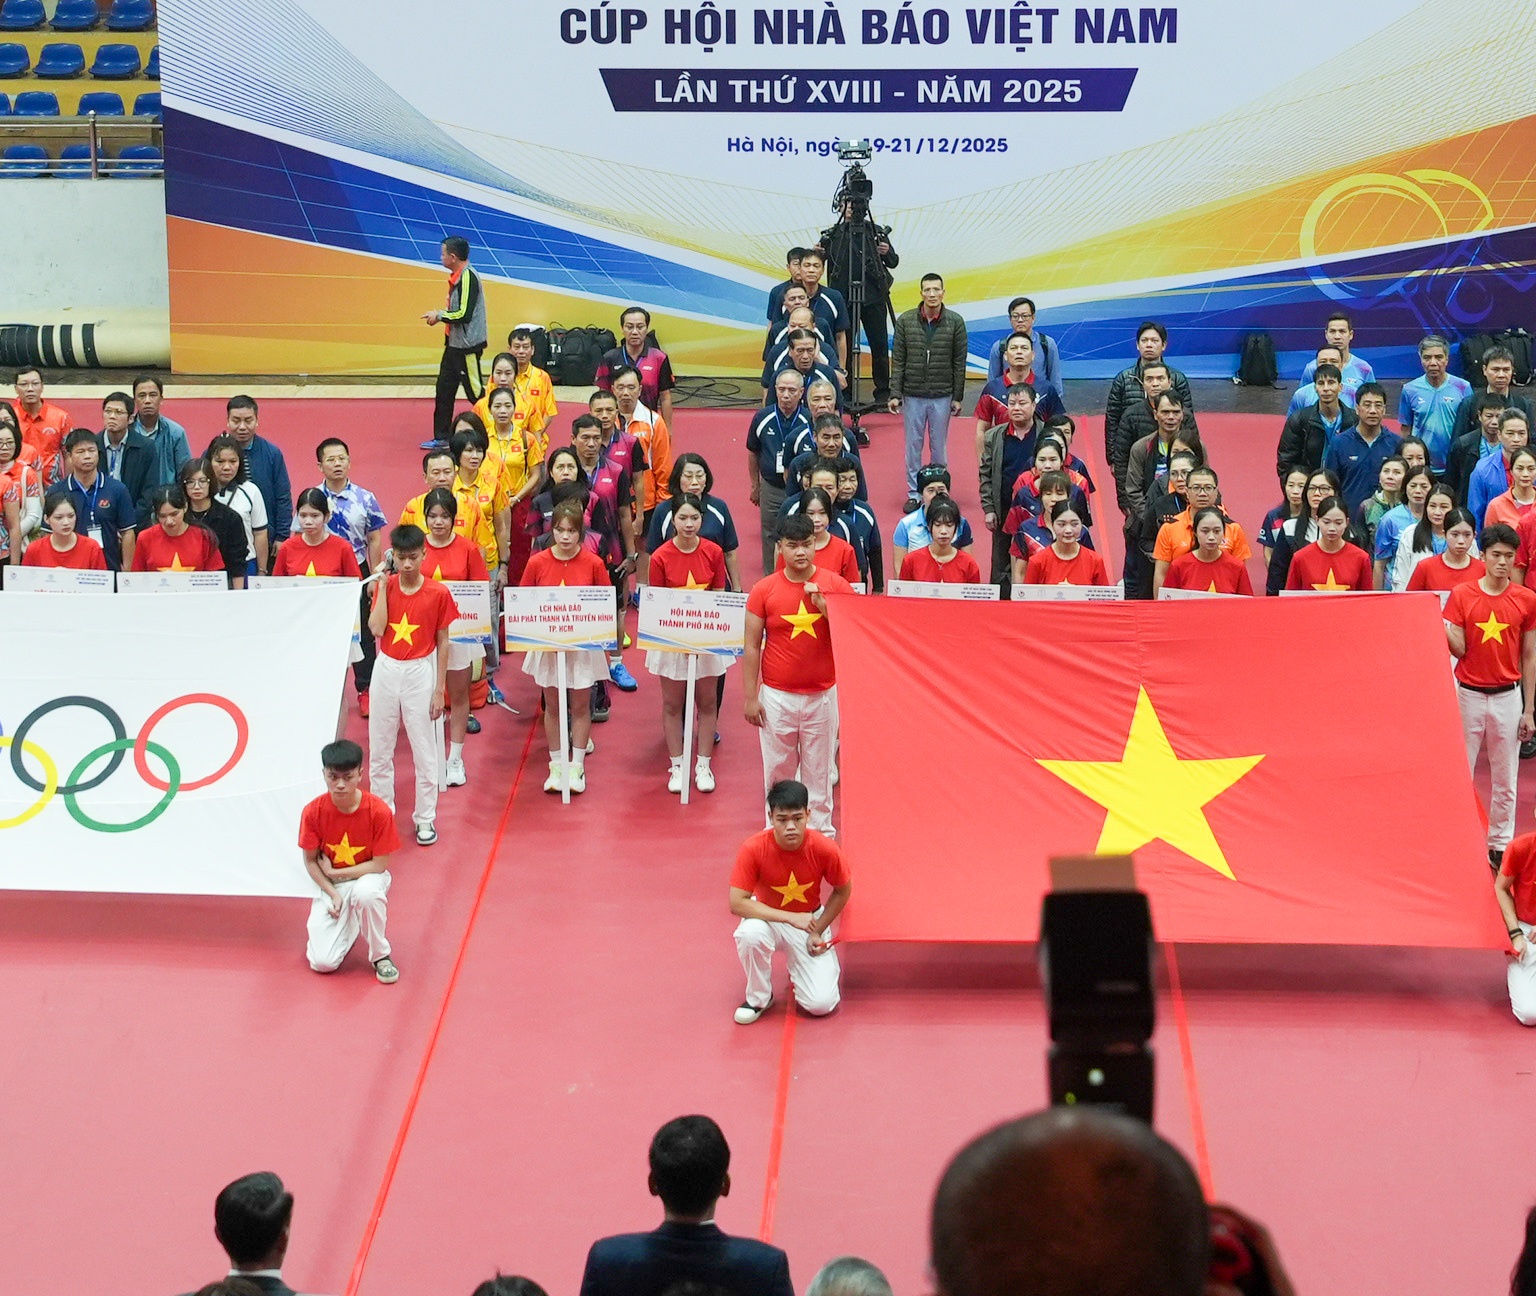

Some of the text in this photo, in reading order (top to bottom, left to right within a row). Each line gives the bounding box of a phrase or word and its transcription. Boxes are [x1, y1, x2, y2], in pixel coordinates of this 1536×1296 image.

[560, 0, 1177, 52] CÚP HỘI NHÀ BÁO VIỆT NAM
[655, 70, 717, 104] LẦN
[728, 74, 797, 104] THỨ
[806, 79, 881, 103] XVIII
[917, 74, 991, 103] NĂM
[1003, 79, 1082, 103] 2025
[727, 136, 754, 152] Hà
[762, 136, 798, 156] Nội,
[806, 136, 840, 156] ngà
[539, 603, 582, 612] LCH NHÀ BÁO
[671, 608, 720, 619] HỘI NHÀ BÁO
[521, 613, 537, 623] PHÁT
[539, 614, 560, 622] THANH
[562, 613, 570, 622] VÀ
[571, 611, 596, 622] TRUYỀN
[598, 613, 614, 622] HÌNH
[549, 625, 574, 633] TP. HCM
[659, 618, 731, 633] THÀNH PHỐ HÀ NỘI
